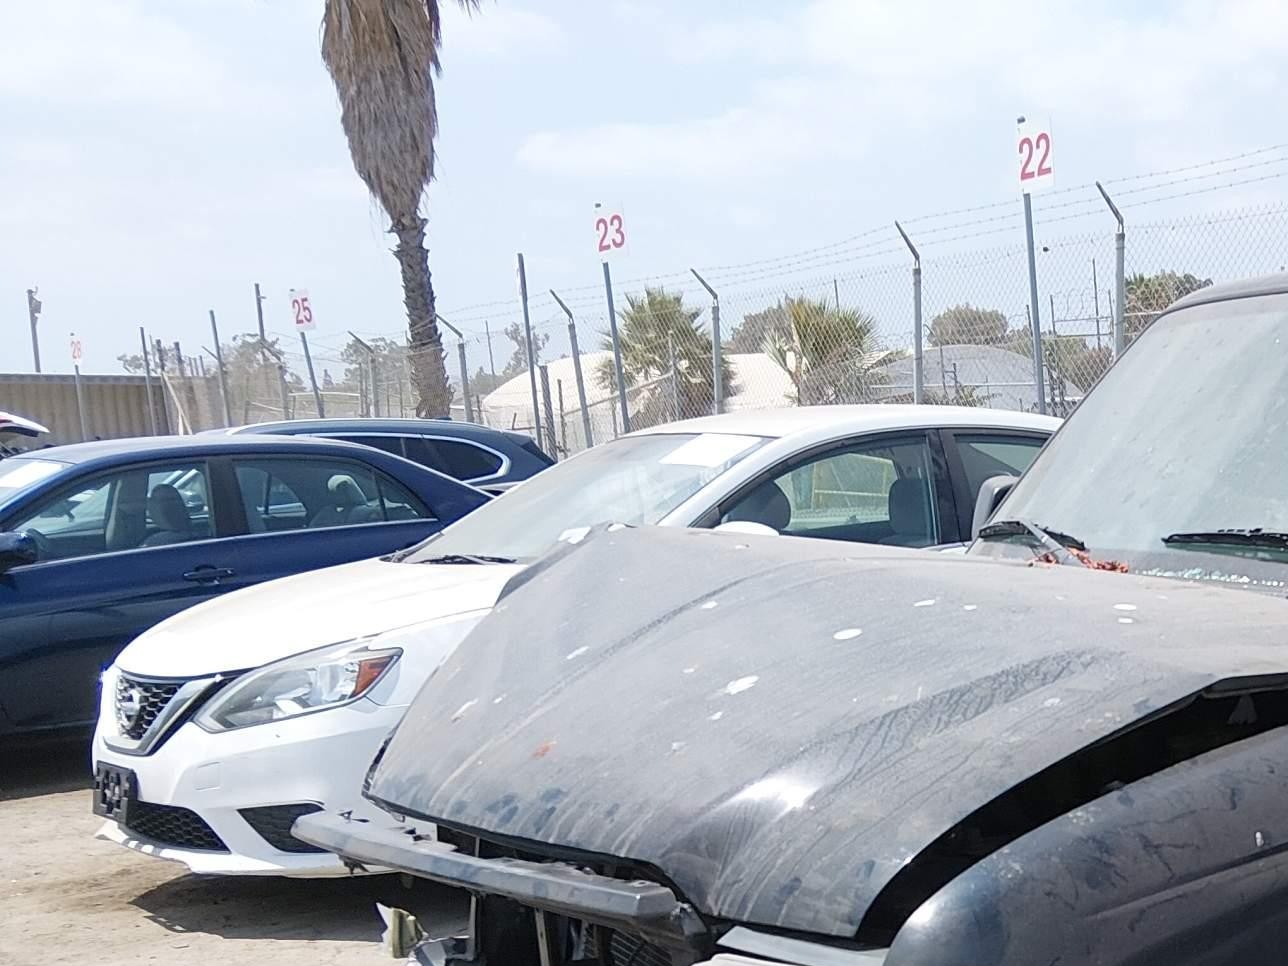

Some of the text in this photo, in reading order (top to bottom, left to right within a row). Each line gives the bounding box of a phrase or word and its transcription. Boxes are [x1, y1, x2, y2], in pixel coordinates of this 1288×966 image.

[1018, 132, 1052, 181] 22
[595, 214, 625, 252] 23
[292, 297, 312, 325] 25
